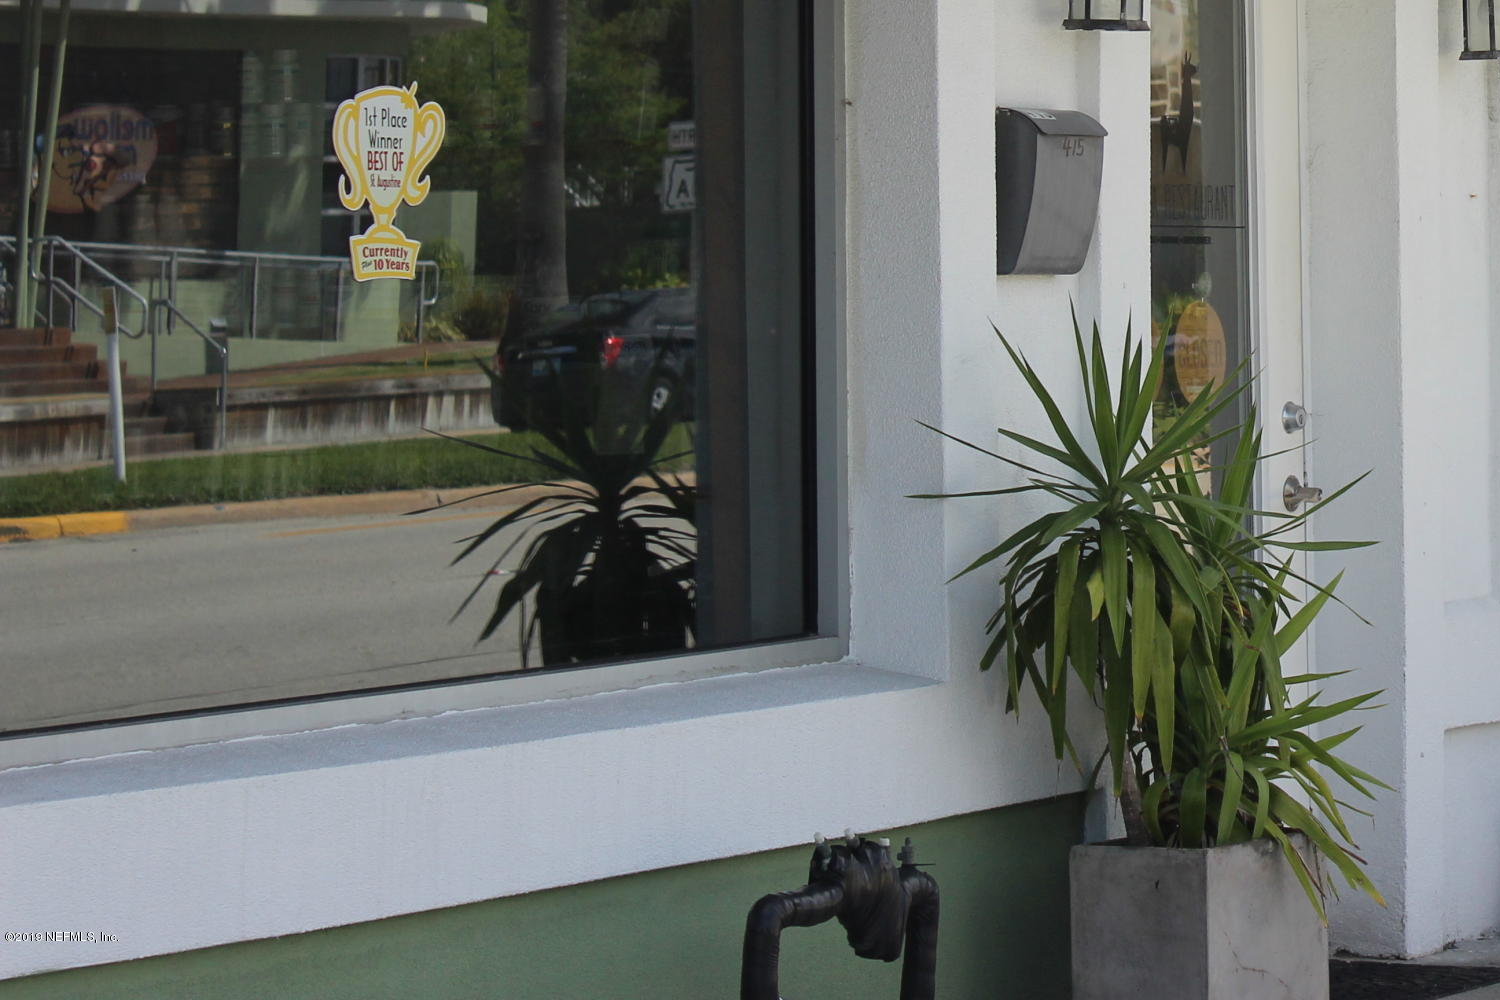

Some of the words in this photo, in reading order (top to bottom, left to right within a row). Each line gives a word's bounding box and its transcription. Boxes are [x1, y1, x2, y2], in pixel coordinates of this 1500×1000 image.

[364, 107, 377, 128] 1st
[381, 108, 408, 128] Place
[368, 129, 403, 149] Winner
[1062, 136, 1085, 157] 415
[367, 150, 388, 171] BEST
[392, 151, 404, 172] OF
[363, 246, 409, 261] Currently
[374, 259, 384, 271] 10
[385, 259, 410, 271] Years
